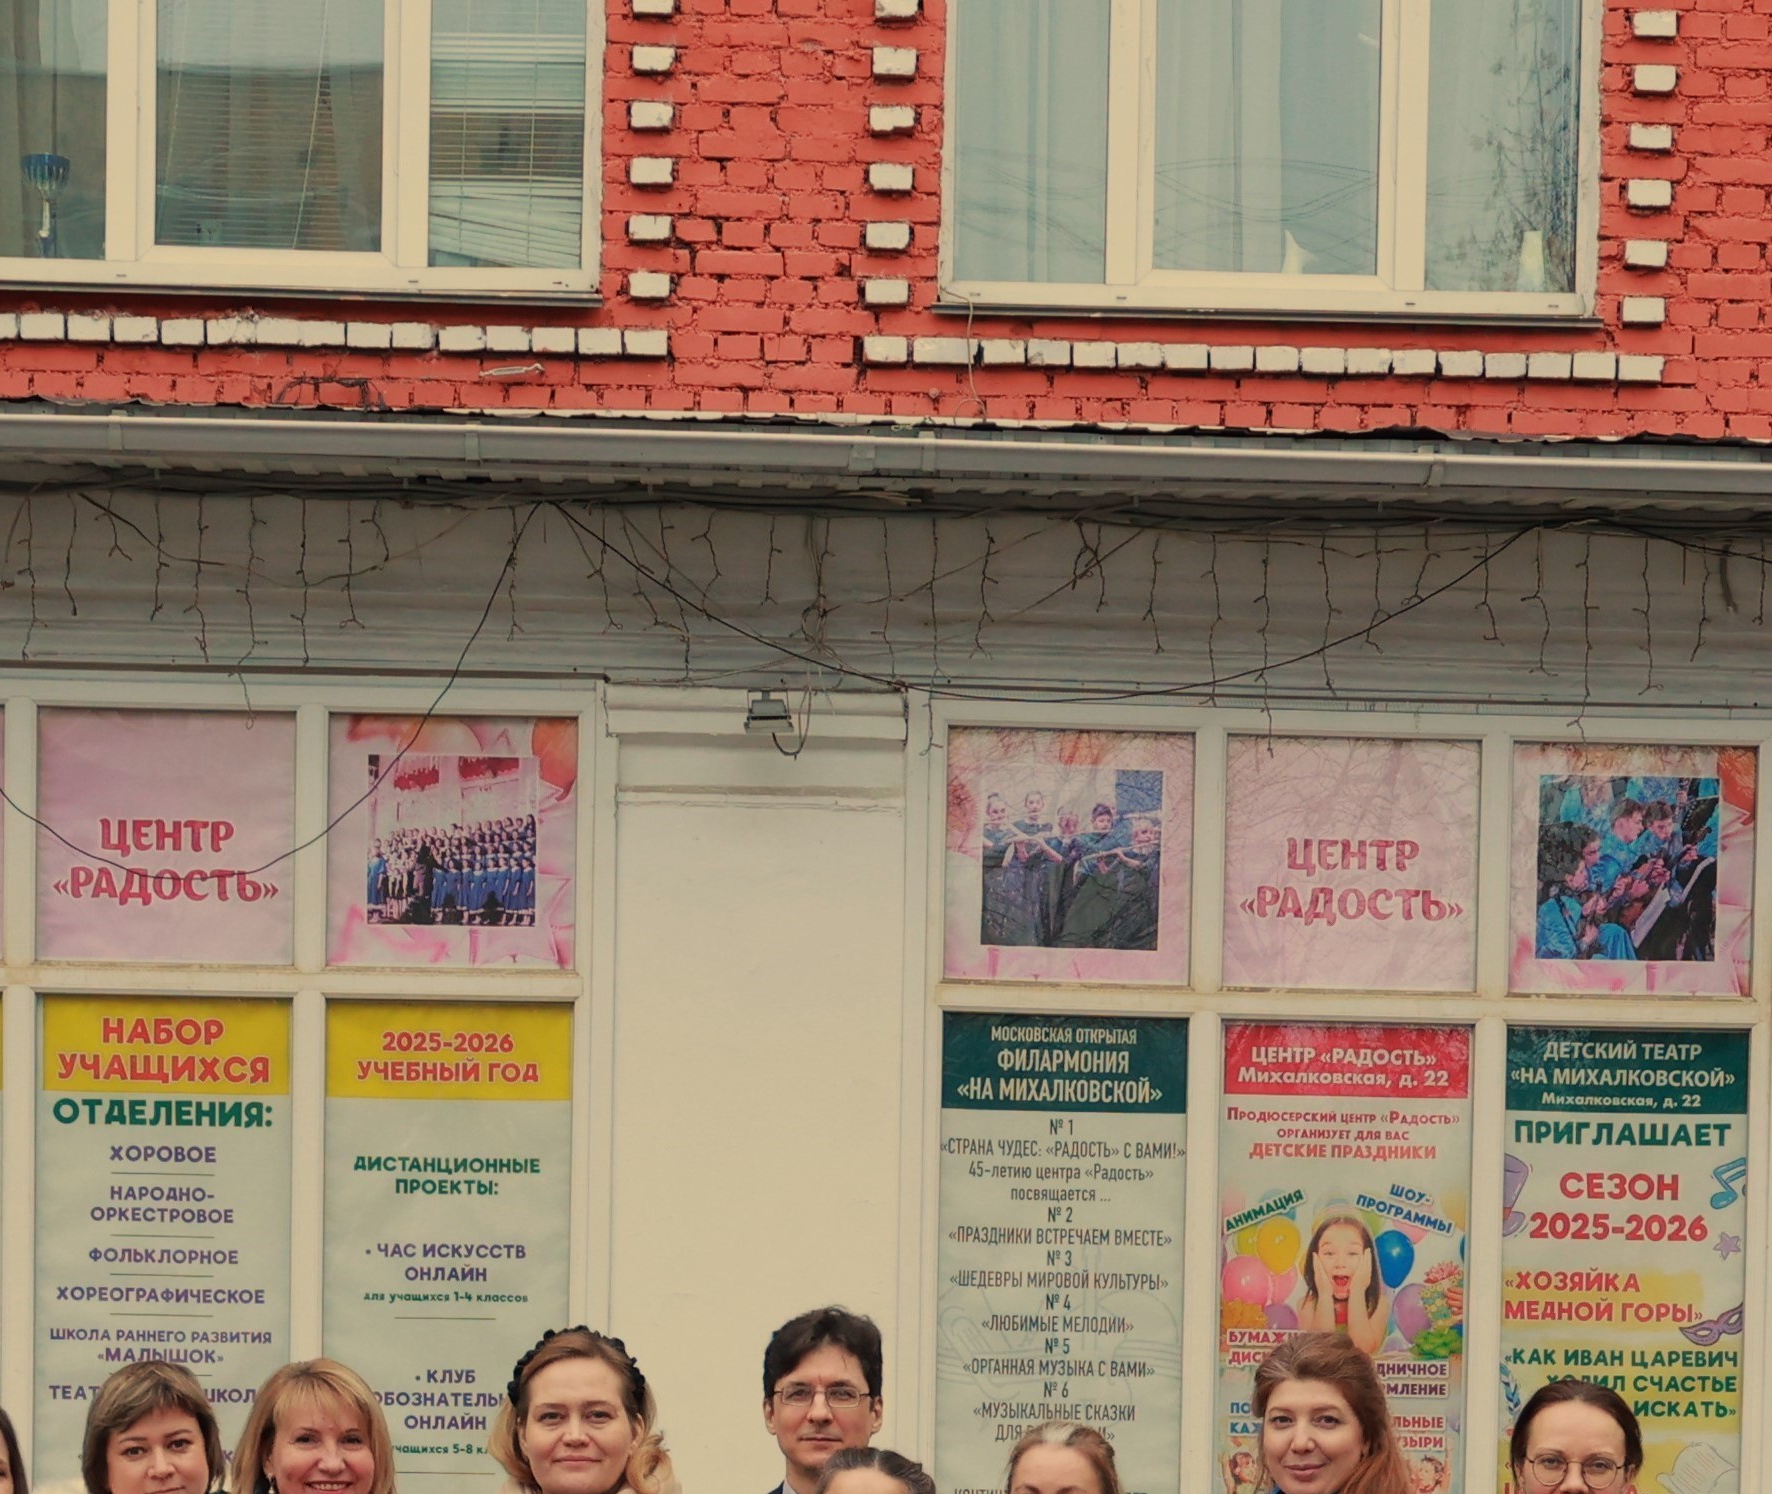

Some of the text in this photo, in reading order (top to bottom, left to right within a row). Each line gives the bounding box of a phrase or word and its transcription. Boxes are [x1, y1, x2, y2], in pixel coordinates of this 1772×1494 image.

[100, 818, 234, 857] ЦЕНТР
[1286, 837, 1419, 877] ЦЕНТР
[53, 866, 279, 906] «РАДОСТЬ»
[1239, 886, 1464, 926] «РАДОСТЬ»
[103, 1017, 224, 1045] НАБОР
[991, 1026, 1137, 1044] МОСКОВСКАЯ ОТКРЫТАЯ
[382, 1032, 514, 1052] 2025-2026
[1543, 1040, 1702, 1061] ДЕТСКИЙ ТЕАТР
[998, 1049, 1128, 1073] ФИЛАРМОНИЯ
[1252, 1047, 1437, 1067] ЦЕНТР «РАДОСТЬ»
[58, 1053, 269, 1085] УЧАЩИХСЯ
[357, 1058, 539, 1082] УЧЕБНЫЙ ГОД
[1238, 1067, 1449, 1088] Михалковская, д. 22
[1511, 1068, 1735, 1087] «НА МИХАЛКОВСКОЙ»
[957, 1077, 1162, 1104] «НА МИХАЛКОВСКОЙ»
[1542, 1092, 1701, 1109] Михалковская, д. 22
[53, 1098, 273, 1128] ОТДЕЛЕНИЯ:
[1515, 1120, 1731, 1147] ПРИГЛАШАЕТ
[110, 1146, 216, 1163] ХОРОВОЕ
[941, 1138, 1186, 1159] «СТРАНА ЧУДЕС: «РАДОСТЬ» С ВАМИ!»
[1249, 1143, 1436, 1161] ДЕТСКИЕ ПРАЗДНИКИ
[354, 1156, 540, 1175] ДИСТАНЦИОННЫЕ
[969, 1161, 1153, 1183] 45-летию центра «Радость»
[110, 1186, 215, 1202] НАРОДНО-
[396, 1179, 498, 1195] ПРОЕКТЫ:
[1011, 1187, 1096, 1202] посвящается
[1559, 1172, 1679, 1200] СЕЗОН
[90, 1207, 234, 1224] ОРКЕСТРОВОЕ
[1226, 1189, 1304, 1231] АНИМАЦИЯ
[1356, 1194, 1452, 1233] ПРОГРАММЫ
[949, 1226, 1172, 1246] «ПРАЗДНИКИ ВСТРЕЧАЕМ ВМЕСТЕ»
[1529, 1212, 1708, 1241] 2025-2026
[89, 1248, 238, 1264] ФОЛЬКЛОРНОЕ
[377, 1244, 526, 1259] ЧАС ИСКУССТВ
[405, 1264, 487, 1282] ОНЛАЙН
[950, 1270, 1168, 1290] «ШЕДЕВРЫ МИРОВОЙ КУЛЬТУРЫ»
[1505, 1267, 1640, 1292] «ХОЗЯЙКА
[57, 1286, 265, 1304] ХОРЕОГРАФИЧЕСКОЕ
[364, 1292, 528, 1304] для учащихся 1-4 классов
[1505, 1298, 1702, 1323] МЕДНОЙ ГОРЫ»
[982, 1315, 1134, 1335] «ЛЮБИМЫЕ МЕЛОДИИ»
[50, 1328, 272, 1344] ШКОЛА РАННЕГО РАЗВИТИЯ
[97, 1347, 223, 1364] «МАЛЫШОК»
[1504, 1348, 1738, 1369] «КАК ИВАН ЦАРЕВИЧ
[427, 1369, 476, 1384] КЛУБ
[963, 1358, 1155, 1377] «ОРГАННАЯ МУЗЫКА С ВАМИ»
[1633, 1375, 1737, 1392] СЧАСТЬЕ
[974, 1402, 1135, 1421] «МУЗЫКАЛЬНЫЕ СКАЗКИ
[1634, 1400, 1736, 1418] ИСКАТЬ»
[404, 1413, 486, 1430] ОНЛАЙН
